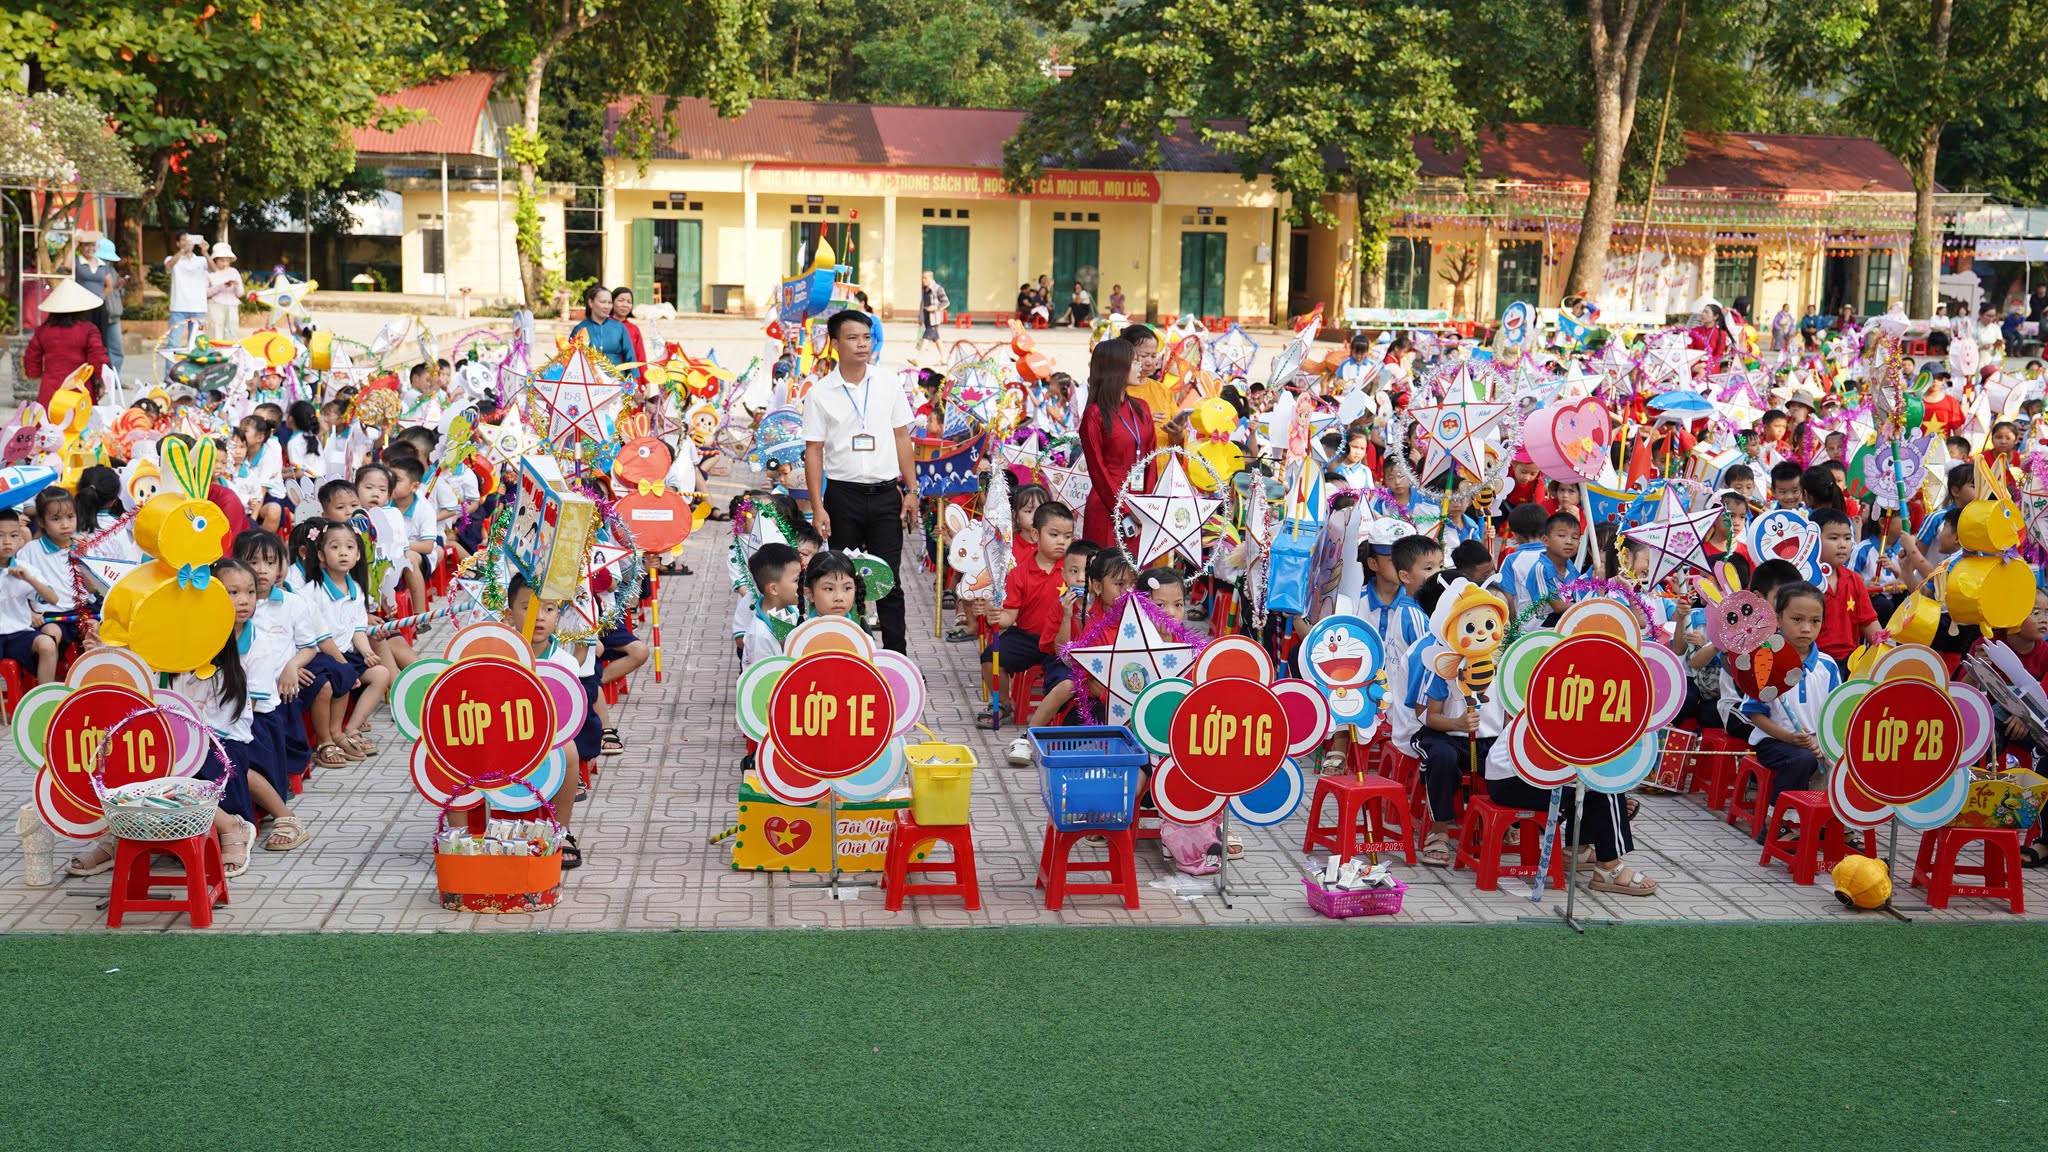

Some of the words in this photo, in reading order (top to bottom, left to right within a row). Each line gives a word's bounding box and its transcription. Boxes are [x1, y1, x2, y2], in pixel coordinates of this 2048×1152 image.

[895, 173, 929, 191] TRONG
[933, 171, 961, 193] SÁCH
[964, 172, 981, 195] VỞ,
[984, 178, 1005, 196] HỌC
[1039, 174, 1054, 194] CẢ
[1057, 180, 1077, 198] MỌI
[1080, 180, 1101, 198] NƠI,
[1104, 180, 1124, 199] MỌI
[1127, 178, 1150, 197] LÚC.
[103, 565, 121, 581] Vui
[443, 690, 492, 746] LỚP
[500, 698, 535, 742] 1D
[791, 681, 838, 736] LỚP
[846, 694, 875, 736] 1E
[1545, 664, 1594, 721] LỚP
[1600, 680, 1631, 723] 2A
[65, 715, 113, 773] LỚP
[122, 729, 156, 774] 1C
[1189, 705, 1237, 756] LỚP
[1241, 713, 1272, 756] 1G
[1862, 707, 1908, 762] LỚP
[1913, 719, 1944, 761] 2B
[837, 841, 867, 856] Việt
[838, 821, 861, 834] Tôi
